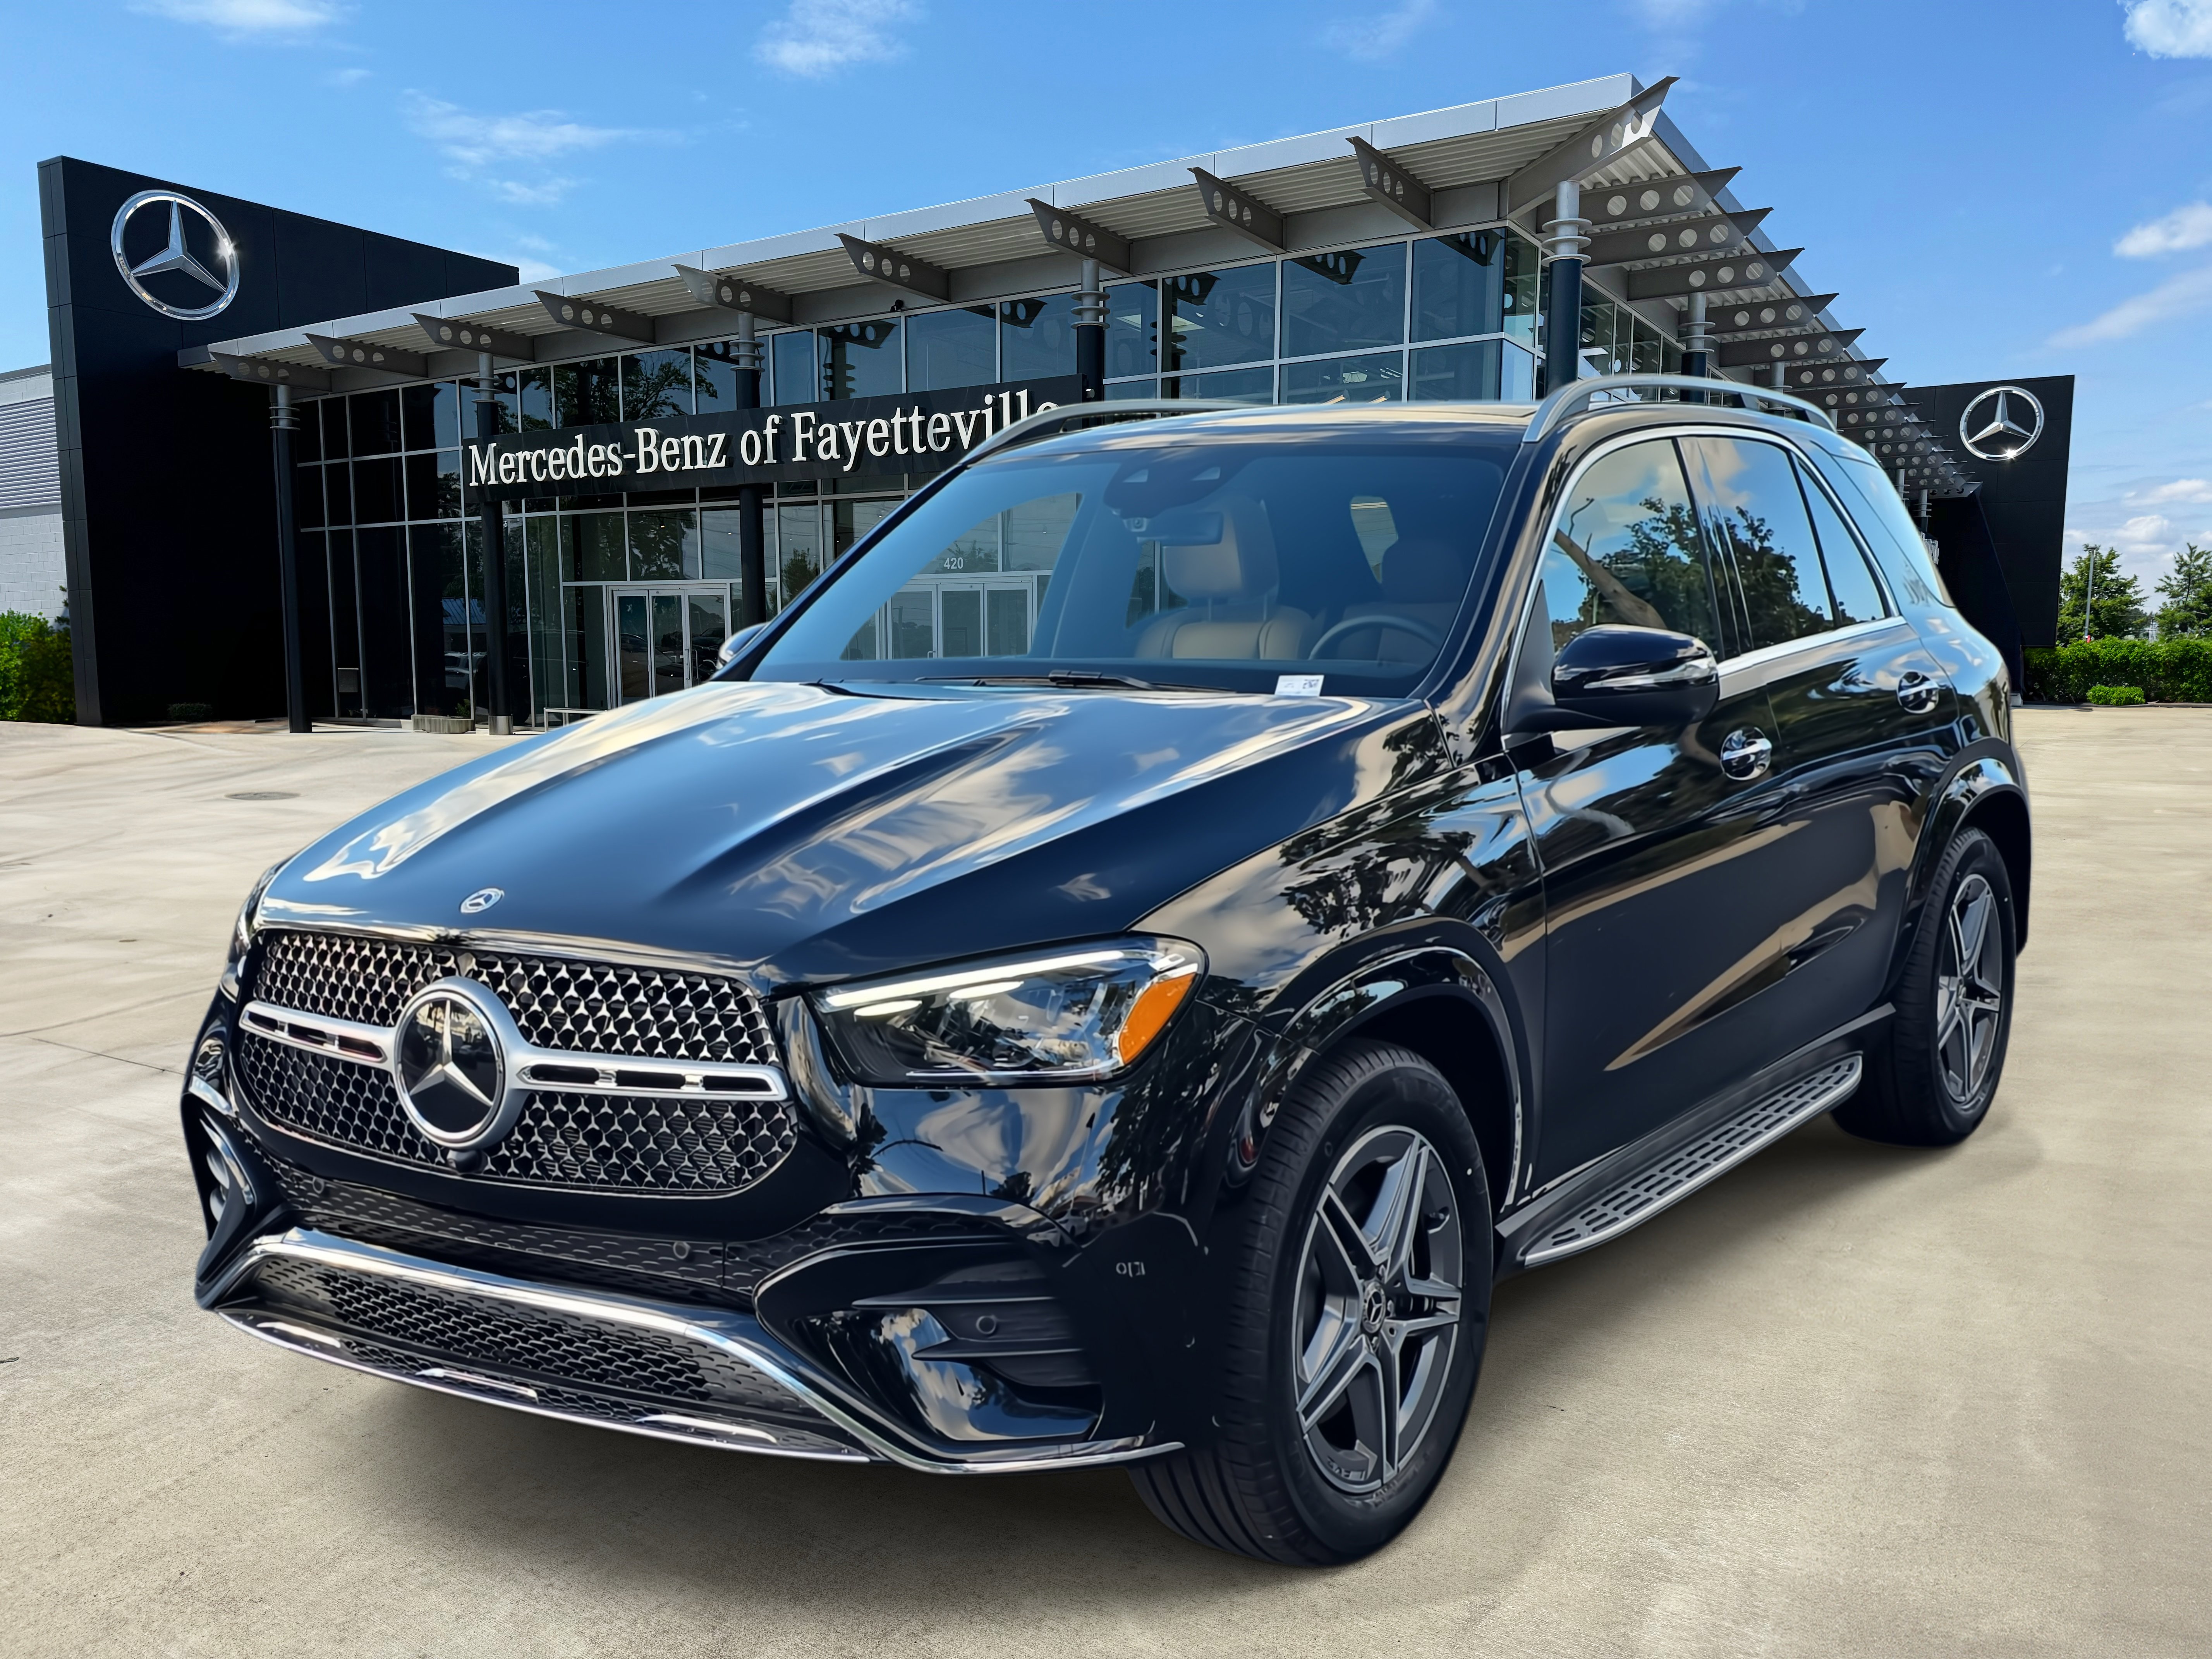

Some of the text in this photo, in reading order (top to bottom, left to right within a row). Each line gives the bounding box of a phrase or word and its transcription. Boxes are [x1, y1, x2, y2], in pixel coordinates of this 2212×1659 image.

[469, 428, 726, 487] Mercedes-Benz
[740, 414, 780, 465] of
[944, 557, 963, 569] 420
